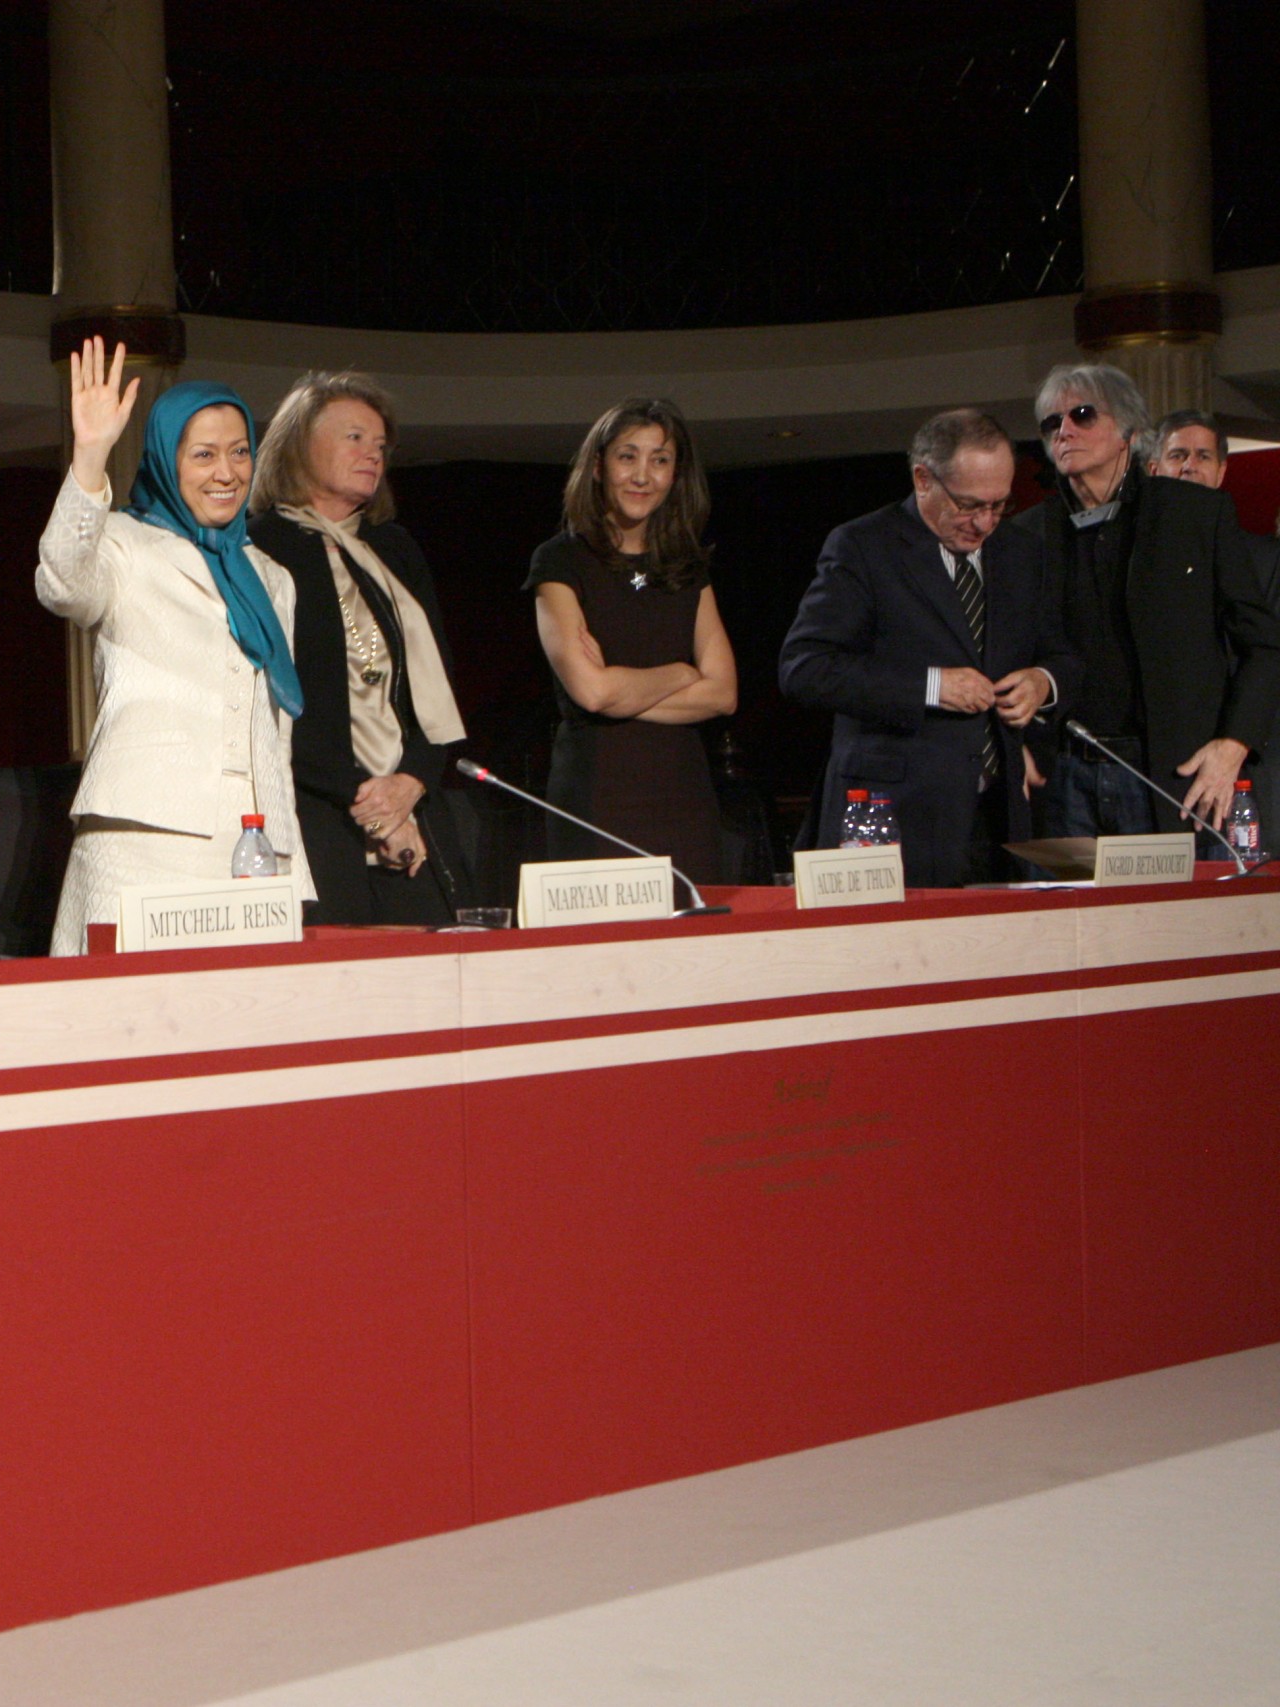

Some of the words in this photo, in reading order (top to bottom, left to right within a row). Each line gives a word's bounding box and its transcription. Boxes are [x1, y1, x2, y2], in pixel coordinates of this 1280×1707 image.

[1105, 856, 1134, 876] INGRID
[1136, 854, 1187, 875] BETANCOURT
[547, 884, 608, 912] MARYAM
[615, 880, 663, 906] RAJAVI
[817, 871, 844, 895] AUDE
[847, 870, 863, 892] DE
[864, 867, 897, 890] THUIN
[150, 905, 235, 938] MITCHELL
[243, 901, 288, 929] REISS
